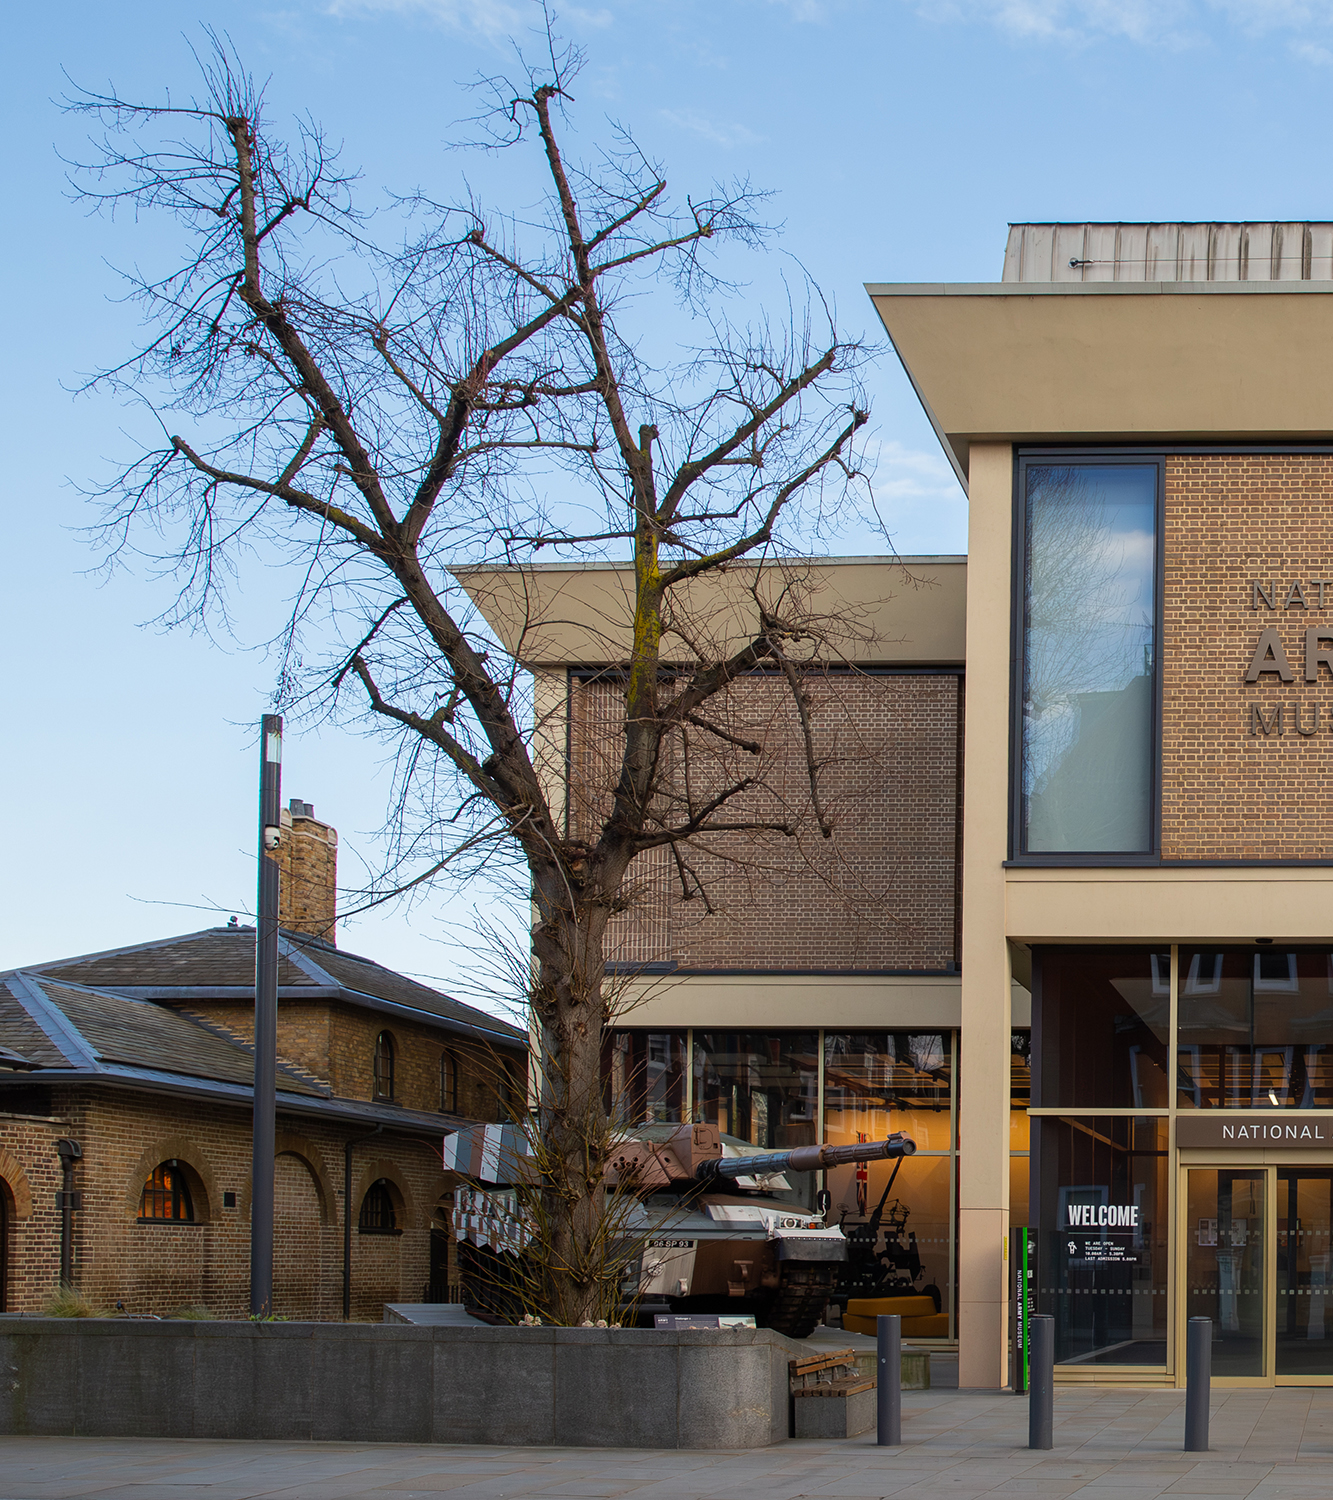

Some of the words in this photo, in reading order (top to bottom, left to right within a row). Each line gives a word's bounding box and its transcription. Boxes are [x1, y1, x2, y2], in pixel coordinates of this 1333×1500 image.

[1222, 1125, 1325, 1139] NATIONAL
[1068, 1204, 1138, 1227] WELCOME
[665, 1240, 678, 1248] SP
[678, 1240, 689, 1248] 93
